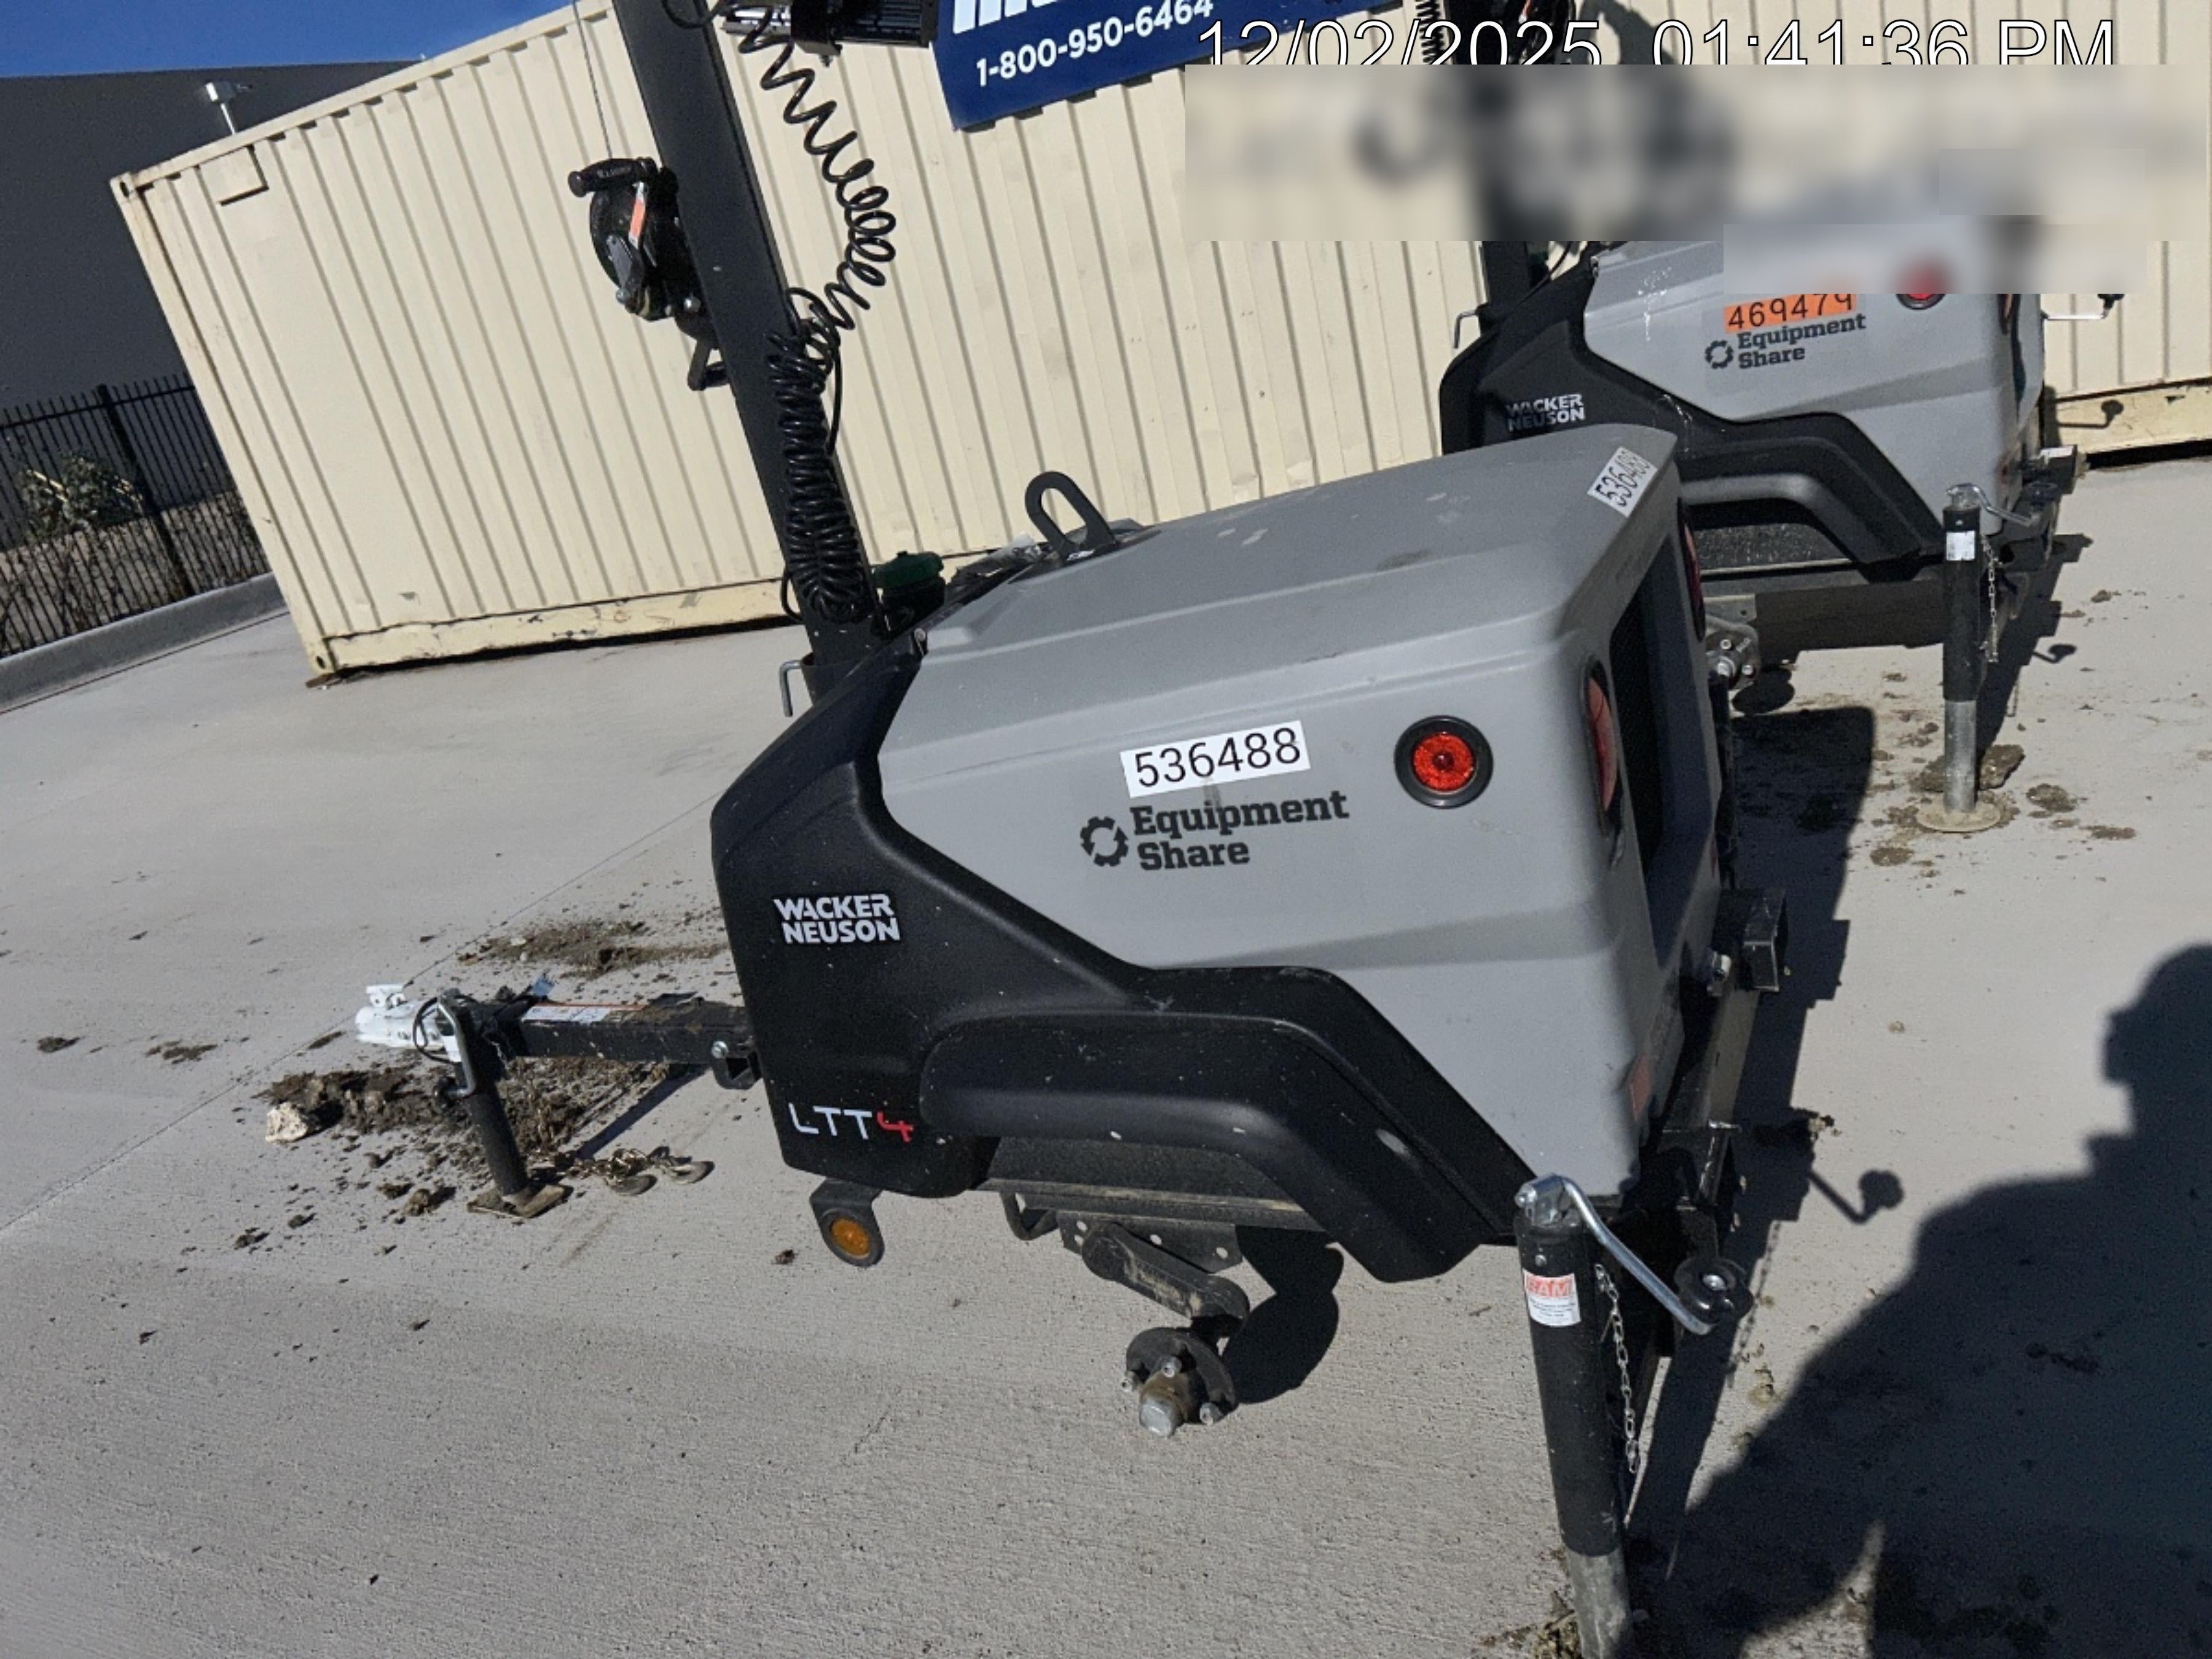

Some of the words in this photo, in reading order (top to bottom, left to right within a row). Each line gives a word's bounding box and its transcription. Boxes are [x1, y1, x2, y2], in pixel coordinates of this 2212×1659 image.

[976, 0, 1214, 87] 1-800-950-6464
[1738, 313, 1867, 350] Equipment
[1738, 347, 1806, 369] Share
[1505, 393, 1585, 418] WACKER
[1507, 406, 1586, 432] NEUSON
[1134, 727, 1301, 788] 536488
[1129, 790, 1350, 839] Equipment
[1137, 840, 1250, 871] Share
[773, 893, 895, 920] WACKER
[782, 917, 901, 944] NEUSON
[788, 1102, 914, 1143] LTT4
